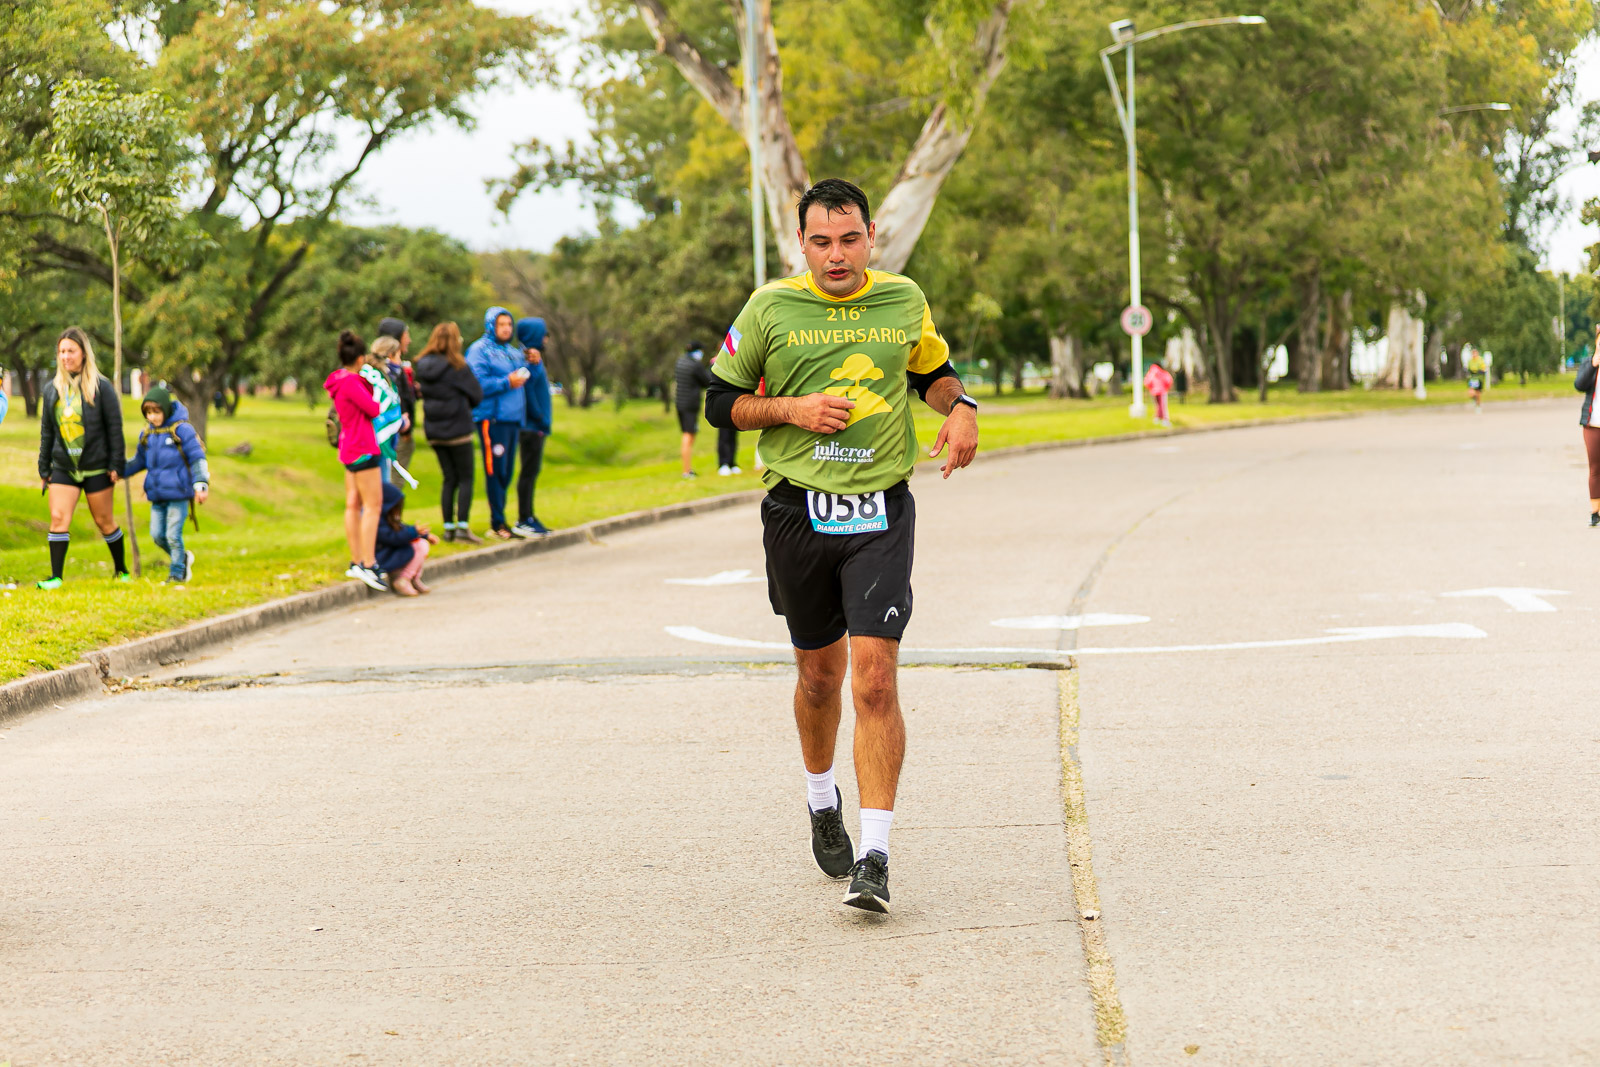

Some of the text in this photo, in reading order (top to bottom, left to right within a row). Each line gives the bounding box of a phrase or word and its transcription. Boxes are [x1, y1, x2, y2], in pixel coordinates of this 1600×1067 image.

[826, 305, 867, 322] 216°
[786, 327, 907, 348] ANIVERSARIO
[811, 440, 876, 460] julicroc
[812, 490, 878, 522] 058
[816, 521, 883, 533] DIAMANTE CORRE
